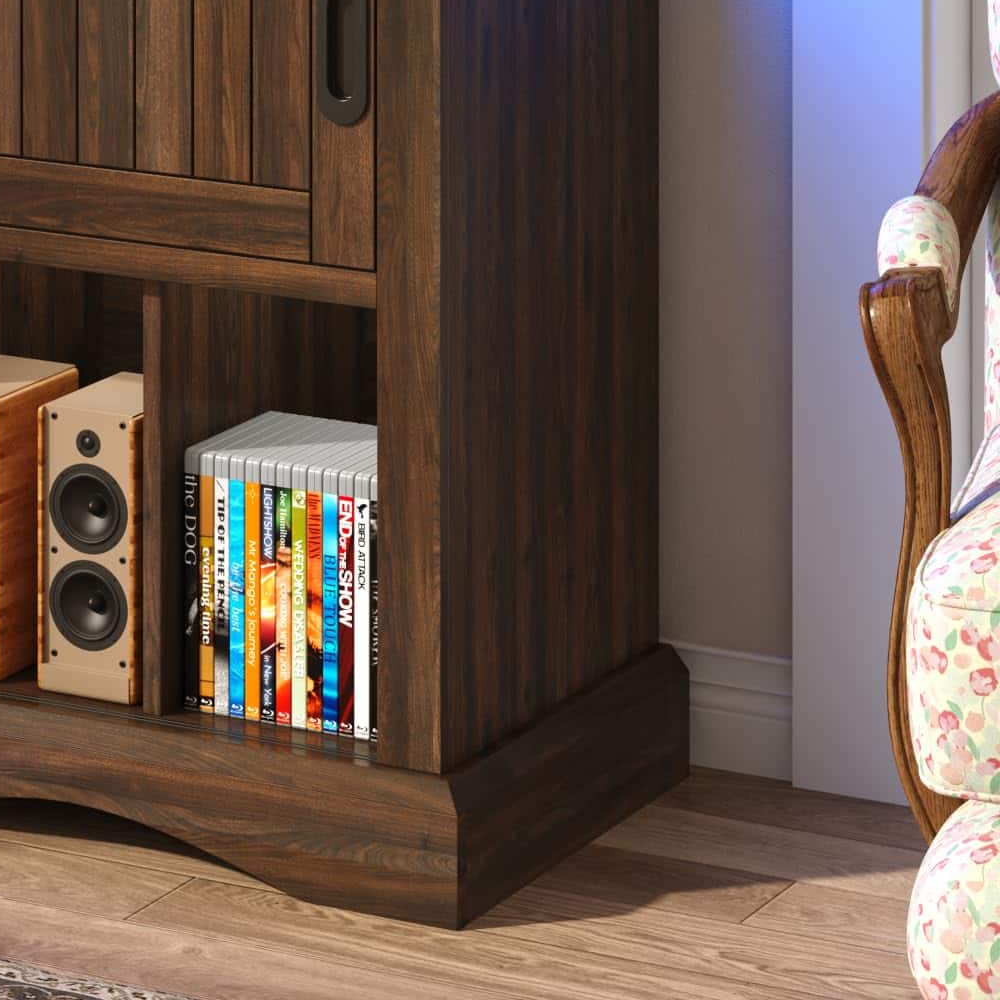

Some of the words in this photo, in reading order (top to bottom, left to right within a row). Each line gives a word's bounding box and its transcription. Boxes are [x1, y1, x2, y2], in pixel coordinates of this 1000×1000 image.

[184, 474, 198, 508] the
[279, 490, 288, 508] Joe
[217, 496, 225, 522] TIP
[263, 487, 273, 560] LIGHTSHOW
[338, 500, 353, 538] END
[184, 515, 197, 565] DOG
[217, 524, 225, 544] OF
[338, 537, 347, 551] OF
[357, 523, 366, 547] BIRD
[201, 547, 212, 607] evening
[217, 549, 225, 577] THE
[294, 539, 305, 606] WEDDING
[324, 554, 337, 600] BLUE
[338, 551, 347, 569] THE
[357, 550, 366, 591] ATTACK
[338, 568, 353, 628] SHOW
[202, 611, 212, 645] time
[324, 605, 337, 663] TOUCH
[263, 664, 272, 685] New
[263, 688, 272, 706] York
